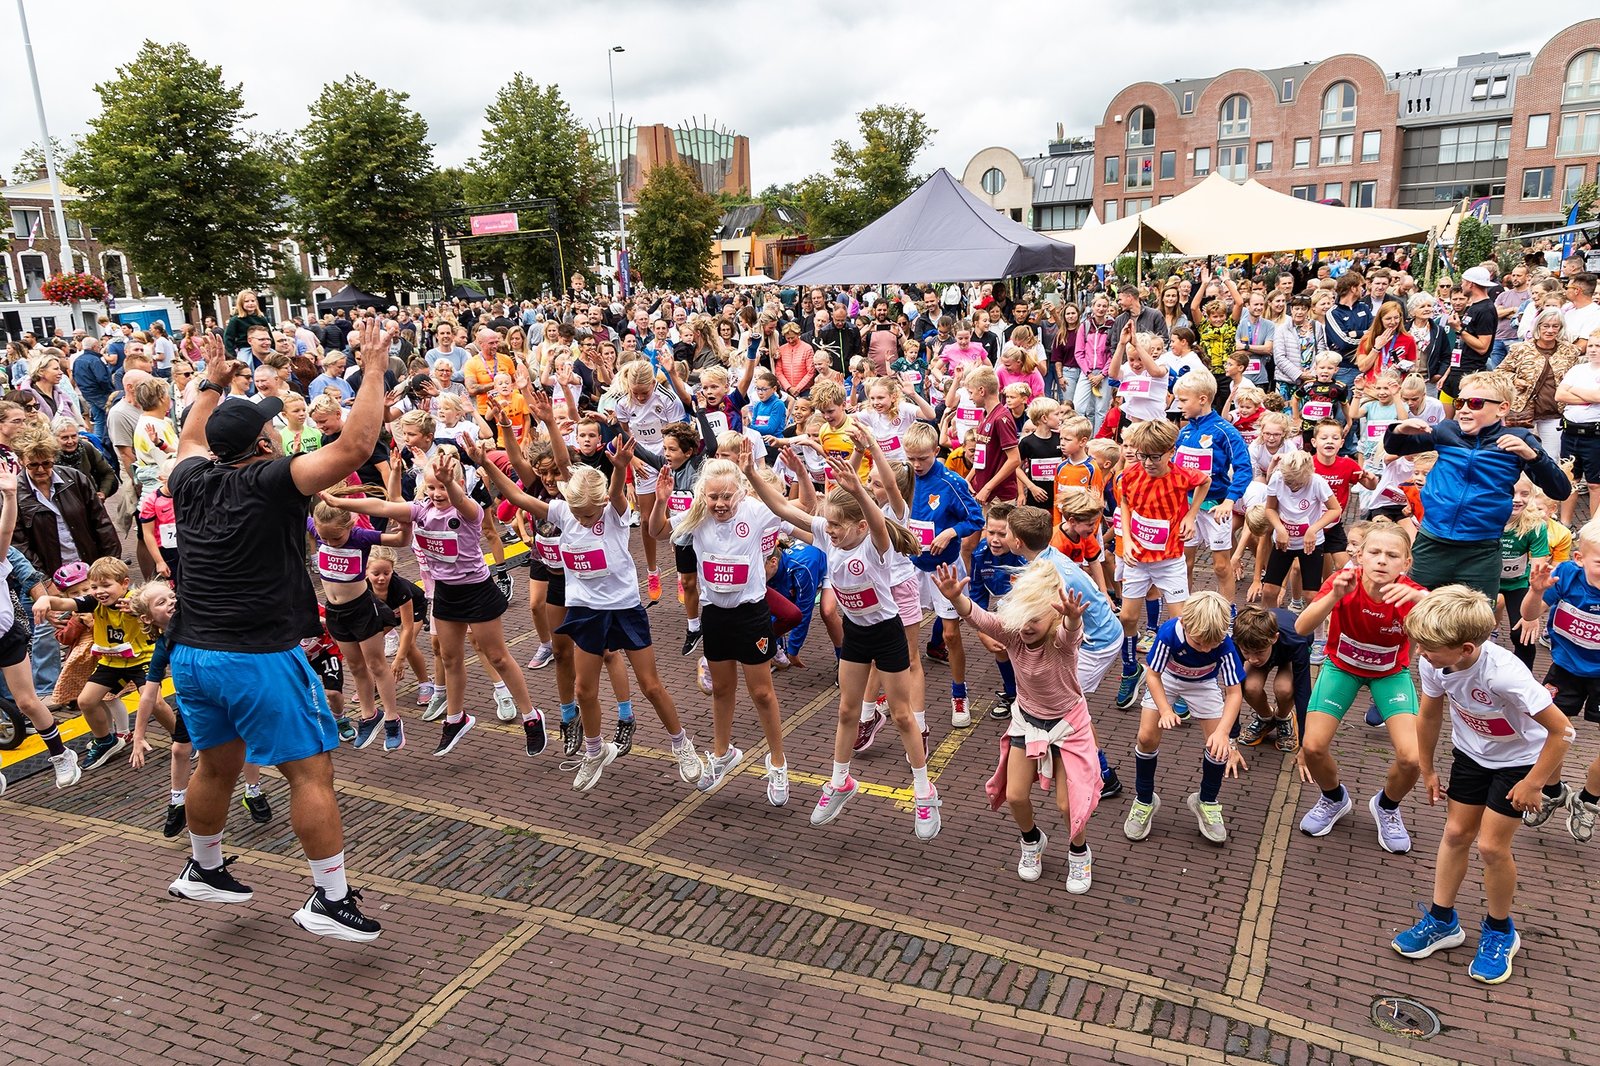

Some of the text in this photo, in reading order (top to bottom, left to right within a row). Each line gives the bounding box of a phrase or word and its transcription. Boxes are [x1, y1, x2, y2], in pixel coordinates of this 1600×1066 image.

[638, 427, 656, 437] 7510
[1182, 461, 1200, 469] 2180
[1136, 523, 1160, 535] AARON
[1137, 531, 1156, 542] 2187
[426, 545, 445, 555] 2142
[327, 555, 350, 565] LOTTA
[327, 563, 349, 573] 2037
[573, 561, 592, 571] 2151
[713, 565, 735, 573] JULIE
[713, 573, 735, 582] 2101
[1572, 619, 1600, 634] ARON
[1568, 625, 1600, 642] 2034
[1351, 651, 1382, 665] 7444
[321, 656, 340, 674] 10
[337, 909, 364, 925] ARTIN
